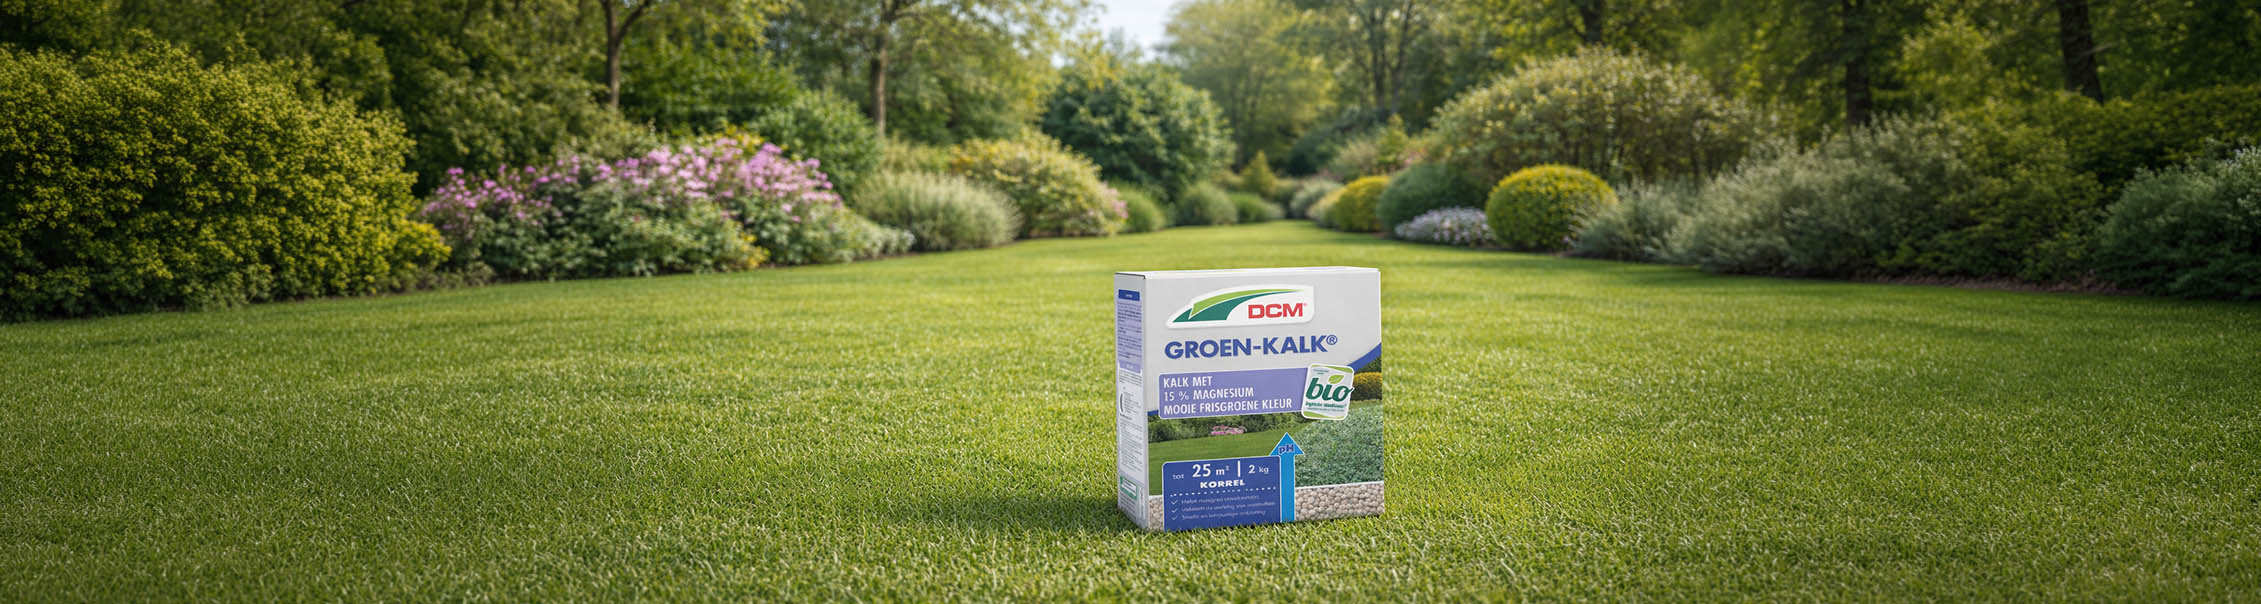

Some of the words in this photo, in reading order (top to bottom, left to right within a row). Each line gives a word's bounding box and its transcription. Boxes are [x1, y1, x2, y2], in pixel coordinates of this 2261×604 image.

[1248, 303, 1303, 319] DCM
[1163, 377, 1189, 388] KALK
[1192, 376, 1212, 387] MET
[1164, 391, 1175, 401] 15
[1178, 391, 1189, 400] %
[1193, 387, 1254, 400] MAGNESIUM
[1305, 377, 1353, 402] bio
[1164, 403, 1196, 415] MOOIE
[1200, 400, 1258, 413] FRISGROENE
[1262, 398, 1292, 409] KLEUR
[1278, 444, 1294, 454] pH
[1192, 463, 1211, 478] 25
[1248, 464, 1255, 474] 2
[1258, 466, 1269, 475] kg
[1200, 479, 1245, 489] KORREL
